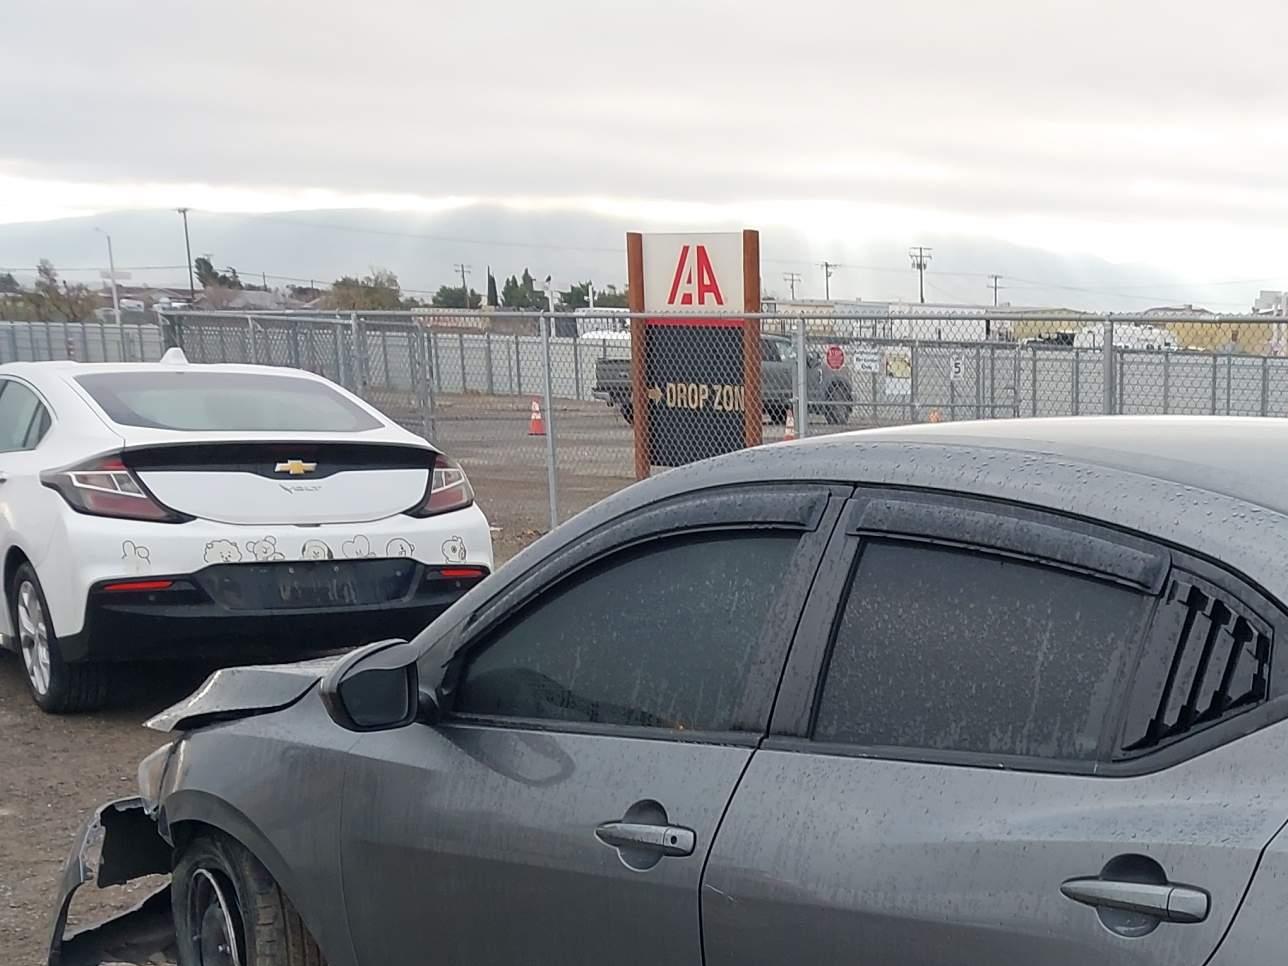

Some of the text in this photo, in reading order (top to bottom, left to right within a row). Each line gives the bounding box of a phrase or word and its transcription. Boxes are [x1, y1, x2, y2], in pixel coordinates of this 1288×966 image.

[953, 362, 961, 375] 5
[666, 382, 745, 412] DROP ZON
